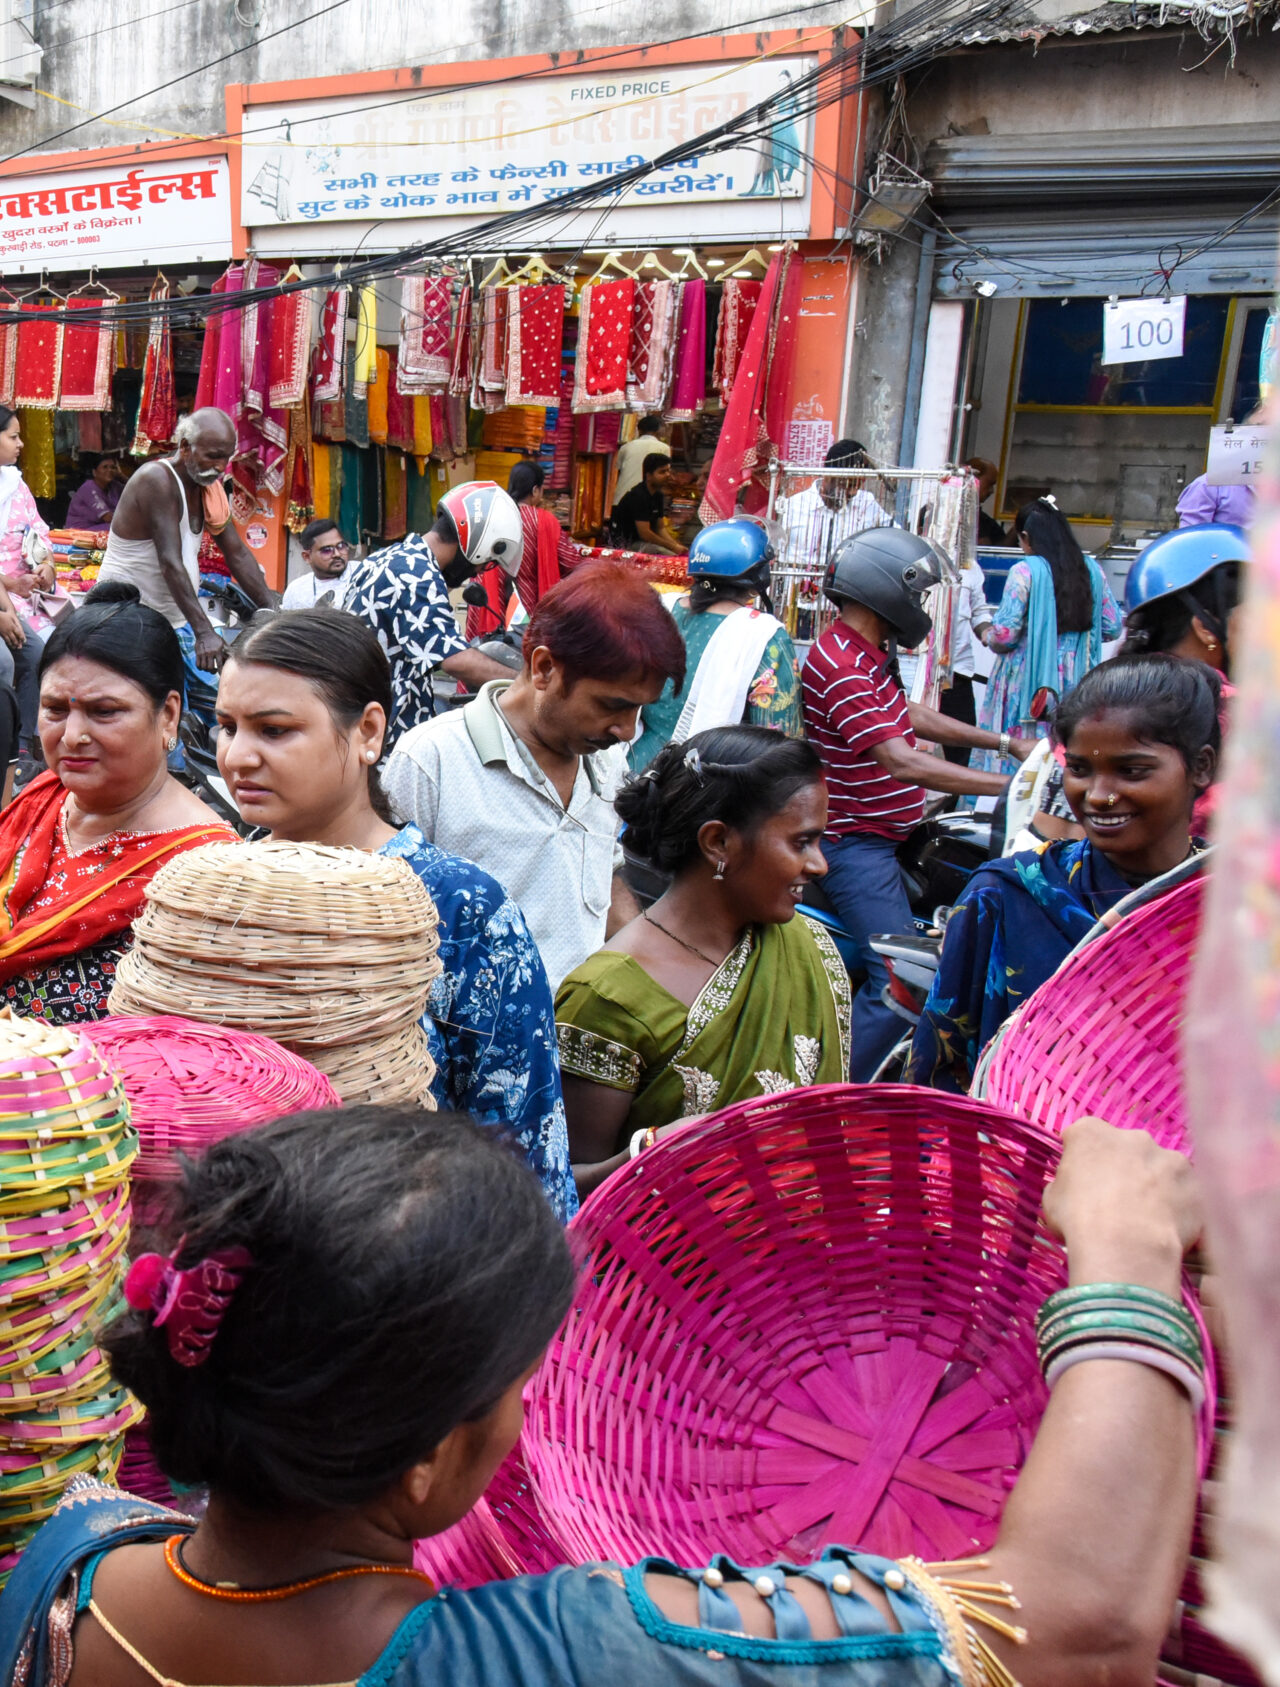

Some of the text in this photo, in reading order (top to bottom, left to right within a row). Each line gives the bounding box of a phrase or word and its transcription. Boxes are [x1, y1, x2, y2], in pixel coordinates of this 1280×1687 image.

[570, 80, 672, 102] FIXED PRICE
[323, 172, 379, 192] सभी
[386, 171, 443, 188] तरह
[450, 166, 481, 184] के
[489, 160, 569, 181] फैन्सी
[297, 199, 337, 219] सुट
[344, 194, 373, 211] के
[380, 191, 438, 208] थोक
[445, 189, 501, 205] भाव
[506, 181, 539, 202] में
[2, 228, 36, 242] खुदरा
[73, 221, 87, 231] के
[90, 217, 133, 230] विक्रेता
[48, 237, 68, 248] पटना
[77, 235, 101, 246] 800003
[1120, 317, 1173, 350] 100
[690, 552, 711, 564] Alto
